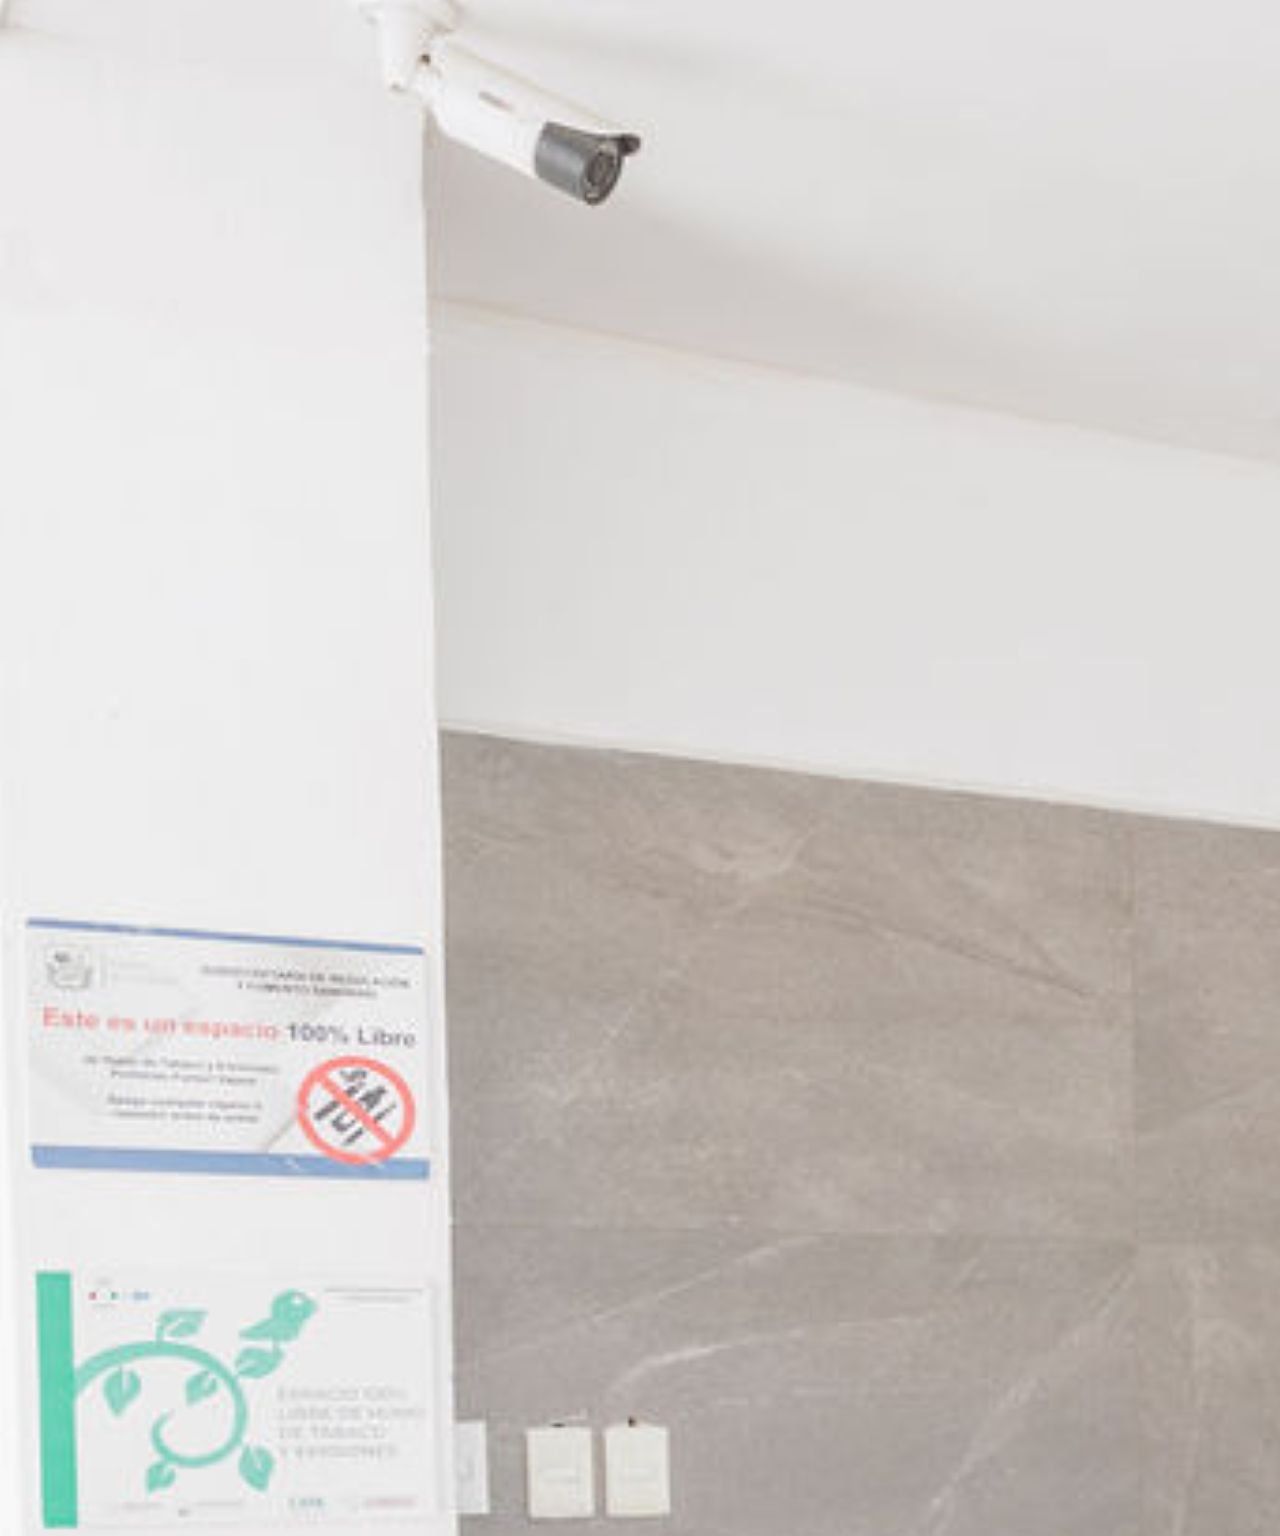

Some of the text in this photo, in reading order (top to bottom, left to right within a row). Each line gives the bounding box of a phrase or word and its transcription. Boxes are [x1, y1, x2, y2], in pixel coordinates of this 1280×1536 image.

[43, 1006, 416, 1049] Este es un espacio 100% Libre
